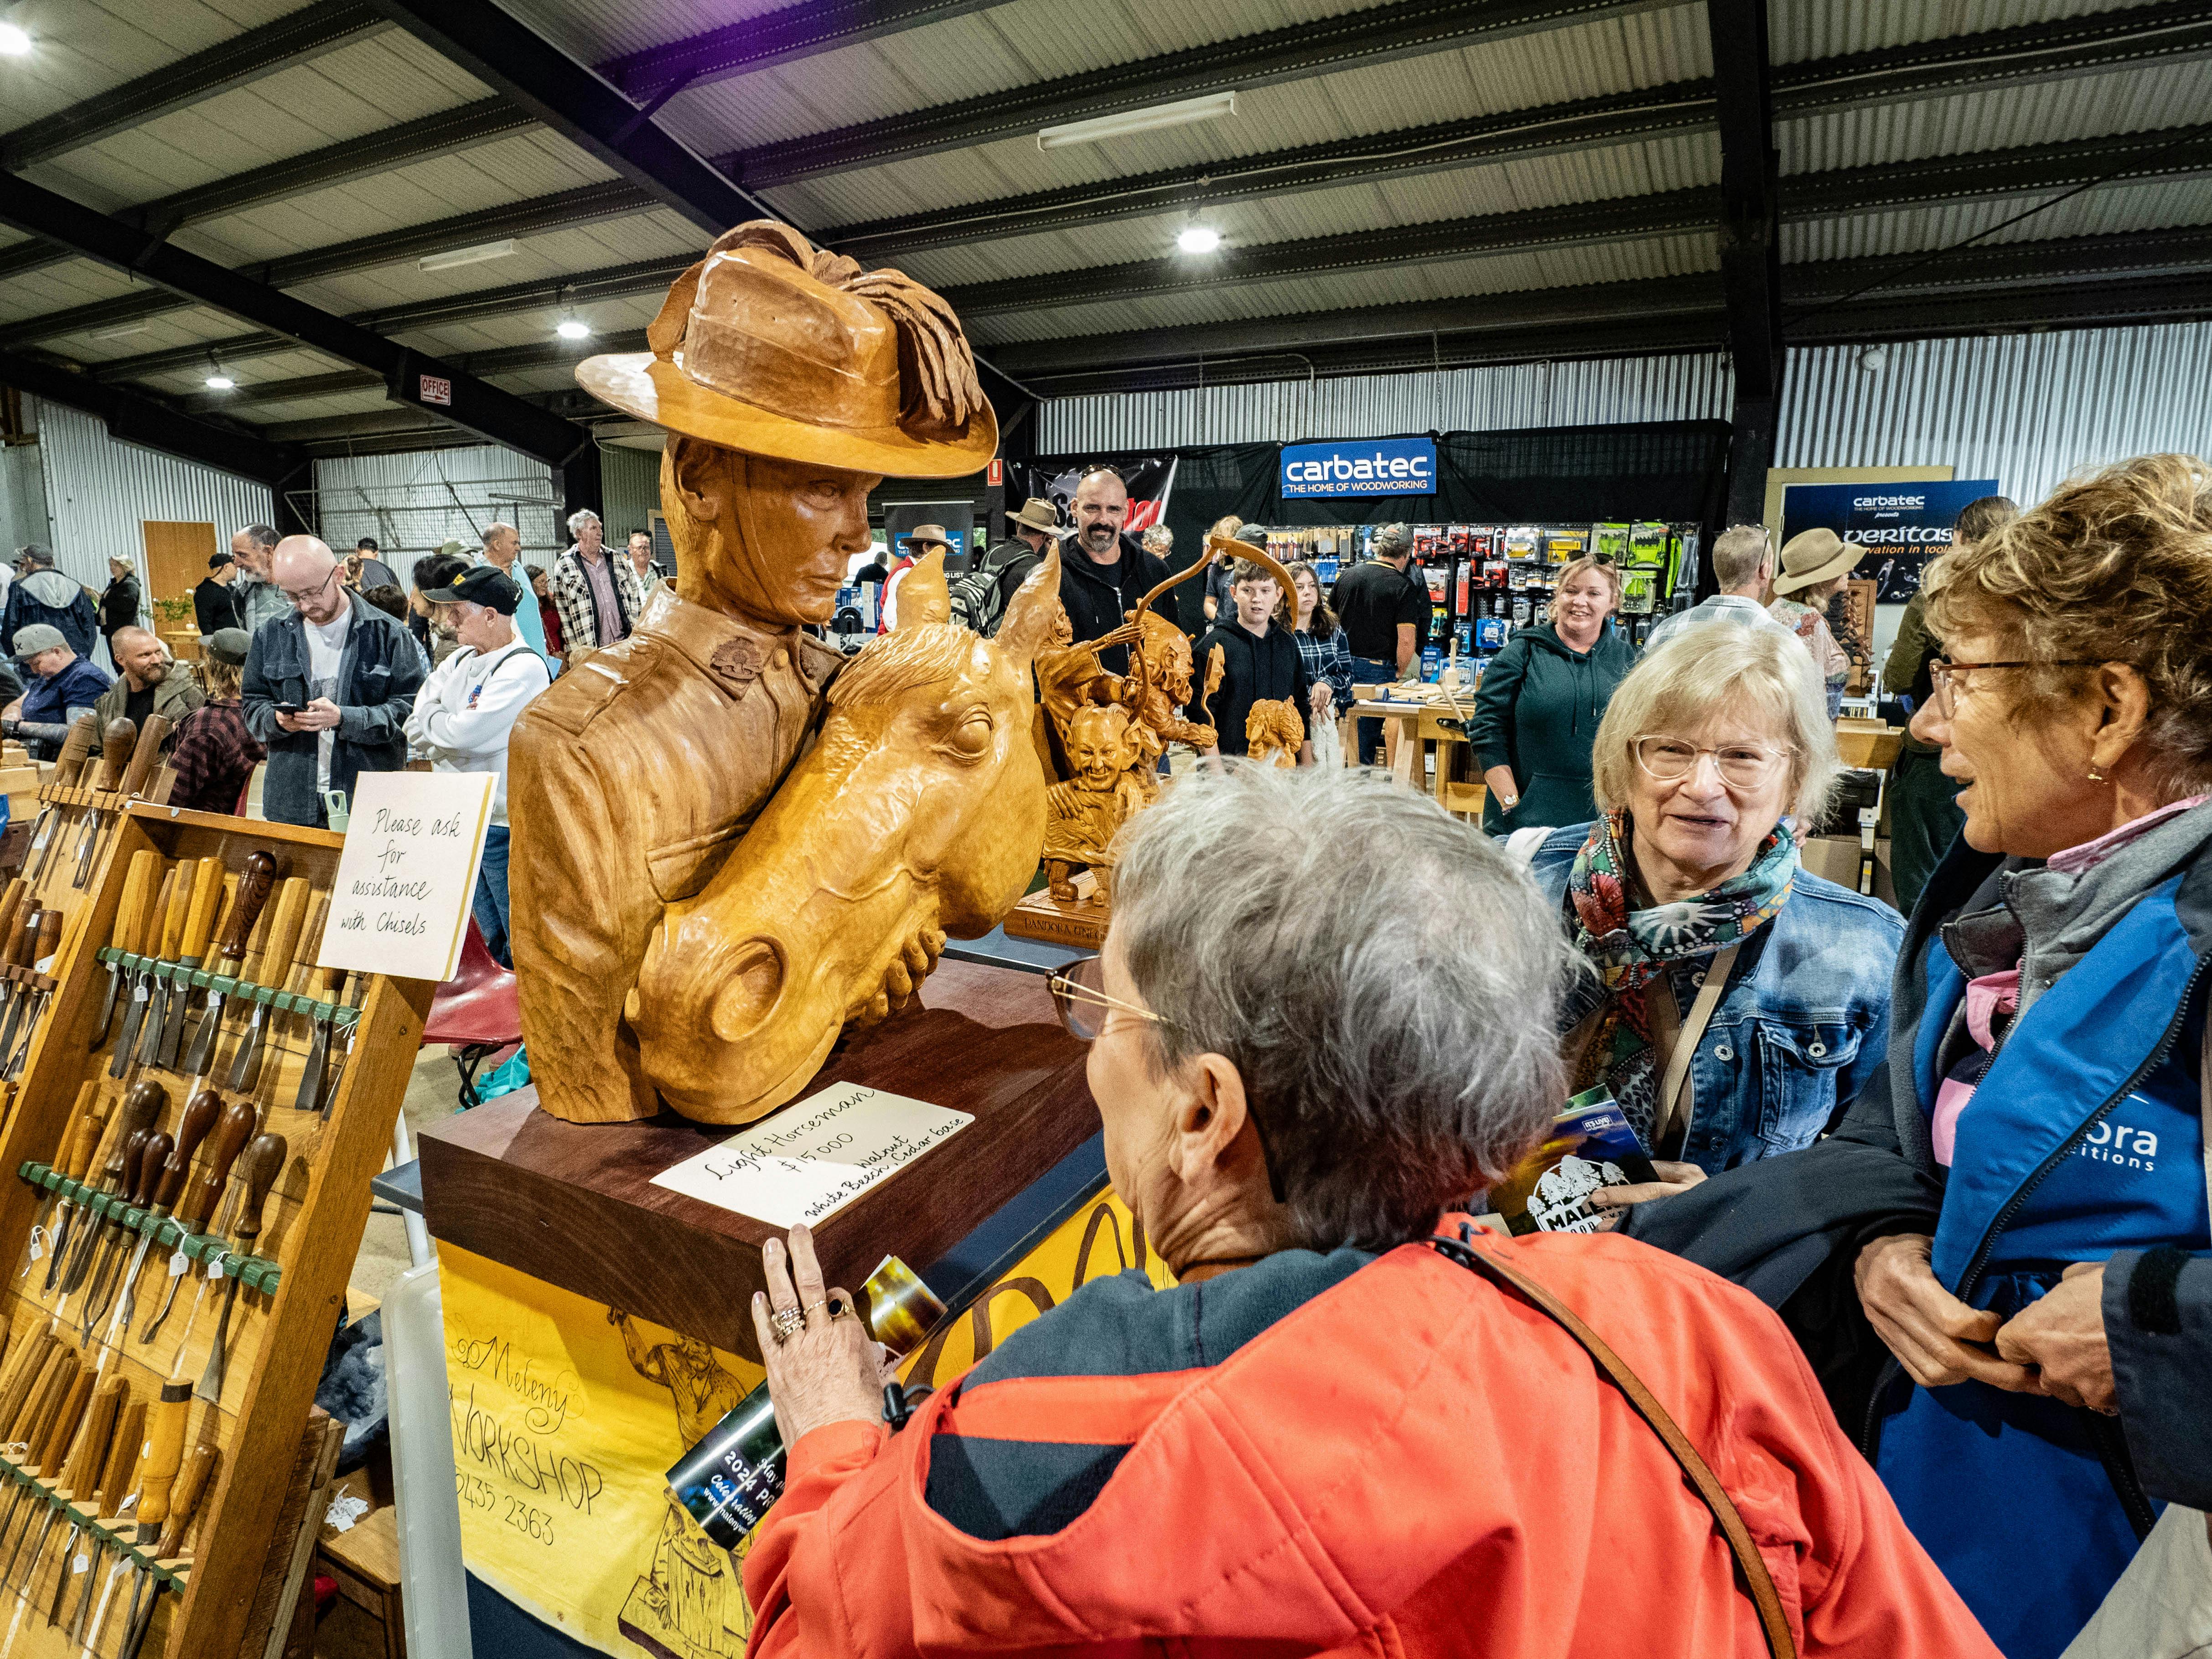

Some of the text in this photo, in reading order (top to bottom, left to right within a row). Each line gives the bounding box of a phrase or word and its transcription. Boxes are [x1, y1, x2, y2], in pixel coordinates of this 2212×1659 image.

[423, 378, 448, 396] OFFICE
[1289, 480, 1428, 493] THE HOME OF WOODWORKING
[1853, 495, 1925, 507] carbatec
[1868, 545, 1948, 554] vation in tool
[372, 808, 461, 837] Please ask
[377, 839, 407, 873] for
[352, 875, 434, 901] assistance
[341, 909, 426, 936] with Chisels
[1025, 918, 1071, 935] PANDORA
[705, 1089, 875, 1180] Light Horseman
[2086, 1120, 2158, 1157] ora
[853, 1135, 908, 1168] Walnut
[2070, 1143, 2155, 1172] itions
[805, 1192, 848, 1218] White
[891, 1135, 932, 1162] Cedar
[929, 1118, 964, 1136] base
[1545, 1201, 1612, 1231] MALE
[724, 1450, 778, 1509] 2024 PR
[756, 1458, 779, 1484] May
[504, 1495, 554, 1545] 2363
